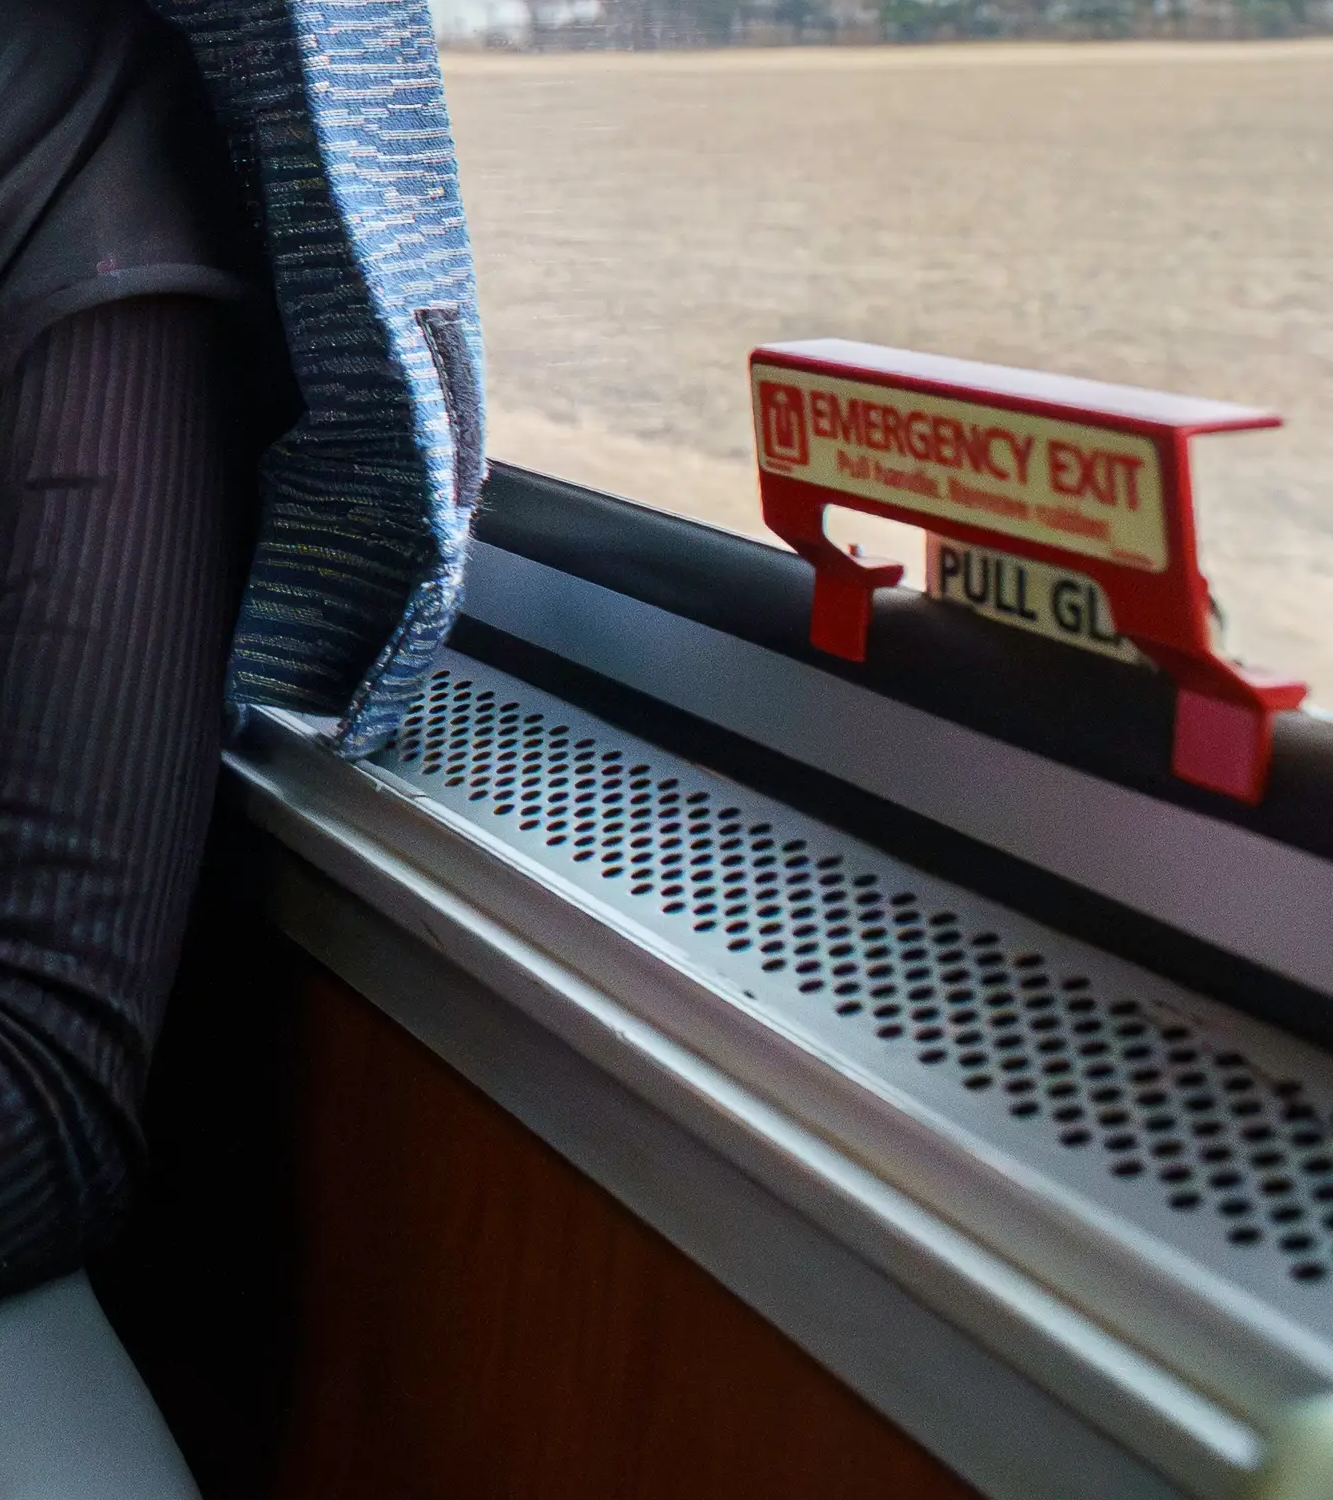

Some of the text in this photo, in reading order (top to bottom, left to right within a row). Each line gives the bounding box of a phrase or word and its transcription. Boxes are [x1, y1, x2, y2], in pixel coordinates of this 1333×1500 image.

[809, 389, 1035, 485] EMERGENCY
[1048, 441, 1145, 512] EXIT
[940, 545, 1038, 622] PULL
